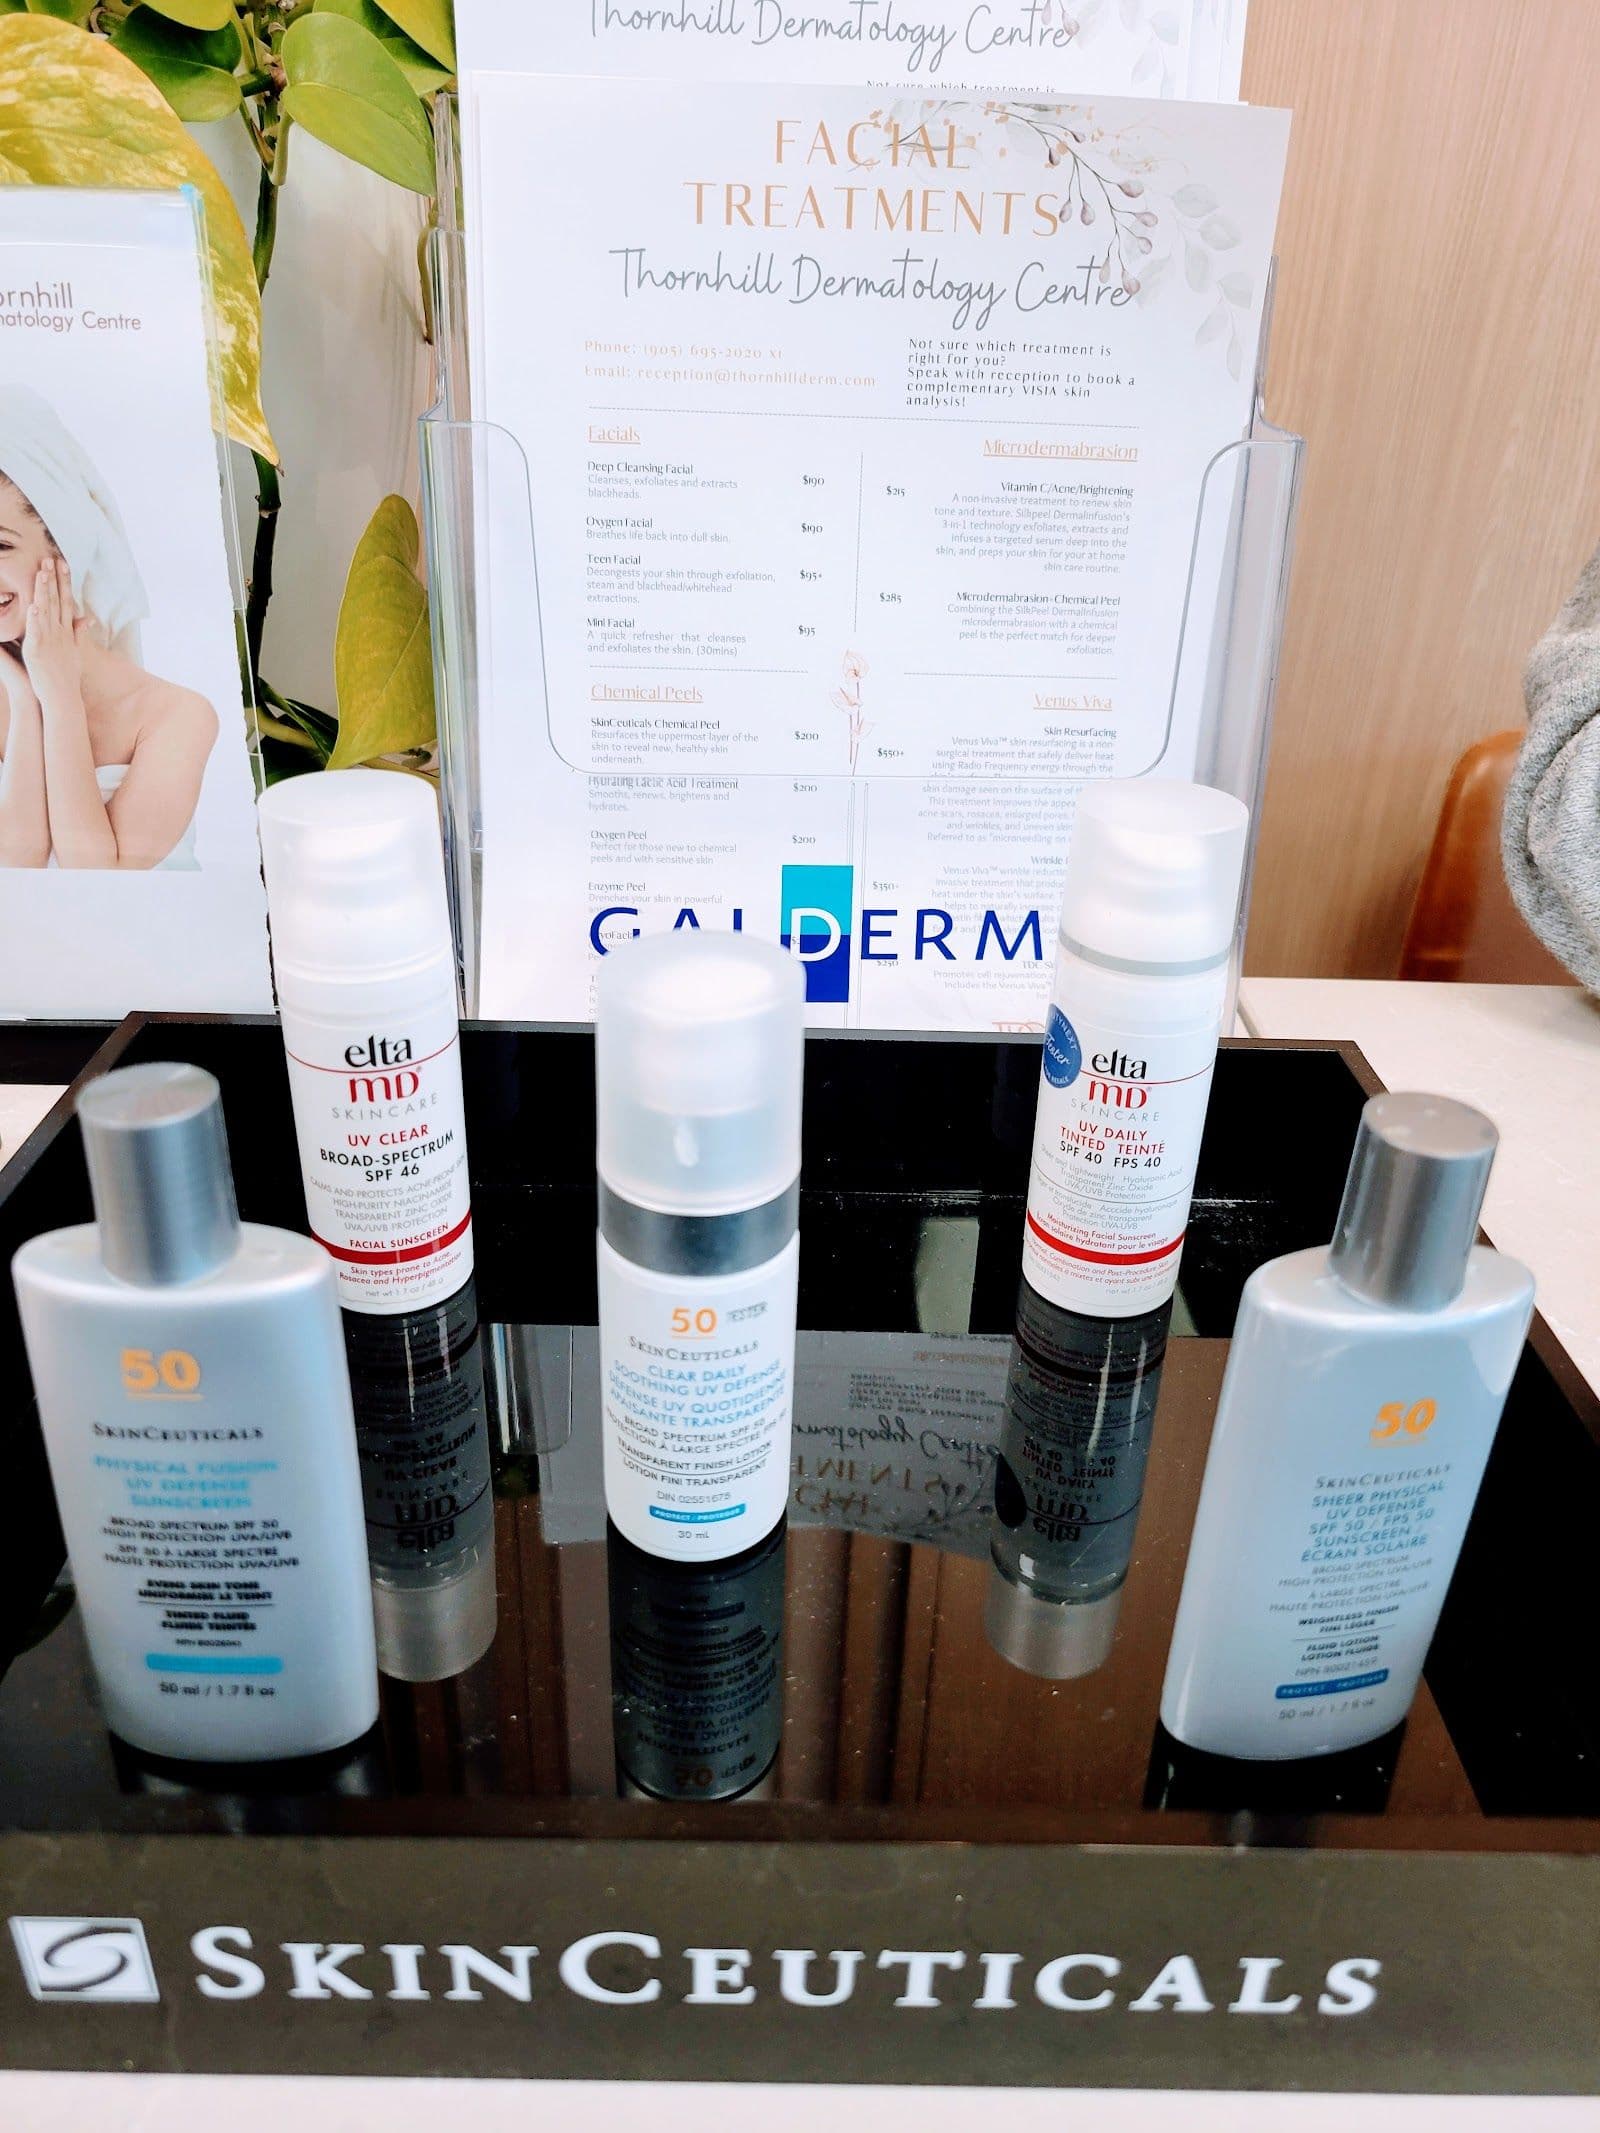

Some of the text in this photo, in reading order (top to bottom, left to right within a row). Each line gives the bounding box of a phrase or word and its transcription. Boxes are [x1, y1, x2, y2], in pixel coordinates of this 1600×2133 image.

[590, 0, 1074, 72] Thornhill Dermatology Centre
[775, 120, 971, 169] FACIAL
[683, 182, 1059, 237] TREATMENTS
[609, 247, 1134, 330] Thornhill Dermatology Centre
[82, 311, 141, 330] Centre
[584, 340, 636, 354] Phone:
[644, 343, 682, 358] (905)
[909, 339, 1112, 356] Not sure which treatment is
[908, 353, 1006, 368] right for you?
[584, 365, 630, 378] Email:
[908, 367, 1135, 386] Speak with reception to book a
[907, 382, 1090, 398] complementary VISIA skin
[906, 396, 966, 408] analysis!
[588, 425, 640, 441] Facials
[984, 440, 1138, 460] Microdermabrasion
[587, 460, 693, 476] Deep Cleansing Facial
[802, 474, 824, 486] $190
[1001, 482, 1038, 493] Vitamin
[586, 516, 653, 530] Oxygen Facial
[801, 522, 823, 533] $190
[586, 530, 626, 540] Breathes
[629, 530, 644, 541] life
[645, 531, 667, 541] back
[670, 532, 688, 542] into
[691, 533, 707, 542] dull
[587, 554, 641, 565] Teen Facial
[1101, 596, 1120, 605] Peel
[587, 618, 635, 628] Mini Facial
[591, 684, 703, 700] Chemical Peels
[1034, 694, 1112, 709] Venus Viva
[591, 718, 720, 729] SkinCeuticals Chemical Peel
[1044, 727, 1117, 738] Skin Resurfacing
[795, 731, 818, 741] $200
[793, 783, 817, 792] $200
[591, 831, 647, 841] Oxygen Peel
[792, 835, 816, 844] $200
[588, 882, 646, 892] Enzyme Peel
[344, 1035, 412, 1069] elta
[1091, 1050, 1147, 1080] elta
[331, 1093, 438, 1120] SKINCARE
[1071, 1098, 1159, 1121] SKINCARE
[348, 1124, 429, 1147] UV CLEAR
[1060, 1127, 1105, 1151] TINTED
[1079, 1120, 1148, 1141] UV DAILY
[320, 1129, 454, 1167] BROAD-SPECTRUM
[1060, 1141, 1161, 1169] SPF 40 FPS 40
[365, 1166, 419, 1182] SPF 46
[350, 1223, 449, 1249] FACIAL SUNSCREEN
[1047, 1213, 1156, 1241] Moisturizing Facial Sunscreen
[340, 1272, 370, 1284] Rosacea
[393, 1252, 461, 1284] Hyperpigmentation
[351, 1267, 367, 1275] Skin
[371, 1268, 393, 1277] types
[396, 1265, 420, 1275] prone
[671, 1307, 718, 1333] 50
[121, 1348, 201, 1391] 50
[614, 1359, 781, 1397] SOOTHING UV DEFENSE
[649, 1364, 747, 1382] CLEAR DAILY
[664, 1401, 684, 1412] UV
[690, 1370, 786, 1414] QUOTIDIENNE
[611, 1385, 784, 1428] APAISANTE TRANSPARENTE
[1370, 1397, 1438, 1440] 50
[618, 1437, 772, 1470] TRANSPARENT FINISH LOTION
[623, 1457, 767, 1486] LOTION FINI TRANSPARENT
[1312, 1481, 1444, 1507] SHEER PHYSICAL
[1327, 1510, 1349, 1520] UV
[678, 1530, 691, 1538] 30
